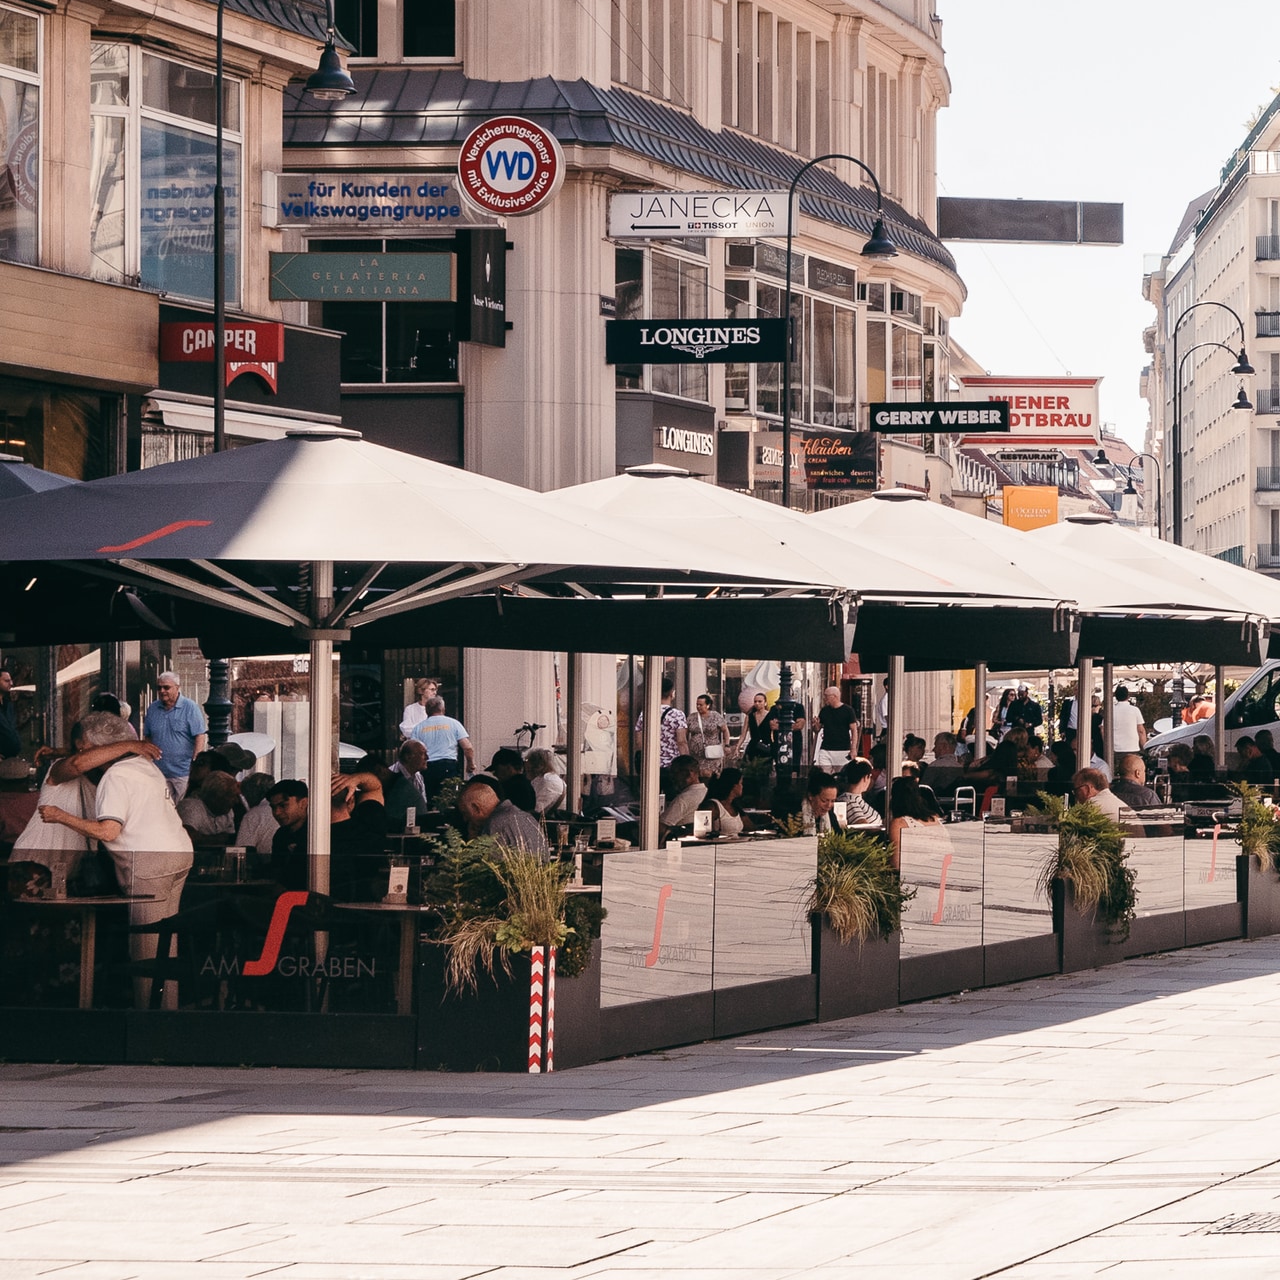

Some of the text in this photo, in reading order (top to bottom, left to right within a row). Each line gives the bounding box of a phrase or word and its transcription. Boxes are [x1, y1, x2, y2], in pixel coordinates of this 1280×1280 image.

[465, 125, 552, 165] Versicherungsdienst
[486, 150, 534, 181] VVD
[308, 181, 448, 198] für Kunden der
[467, 169, 550, 208] mit Exklusivservice
[281, 201, 461, 221] Volkswagengruppe
[630, 196, 775, 218] JANECKA
[360, 258, 379, 267] LA
[312, 272, 426, 281] GELATERIA
[320, 286, 419, 294] ITALIANA
[640, 327, 761, 345] LONGINES
[875, 409, 1002, 426] GERRY WEBER
[1010, 413, 1092, 427] DTBRÄU
[662, 426, 714, 456] LONGINES
[1000, 452, 1058, 461] RESTAURANT
[293, 659, 309, 672] Sale
[200, 955, 376, 978] AM GRABEN
